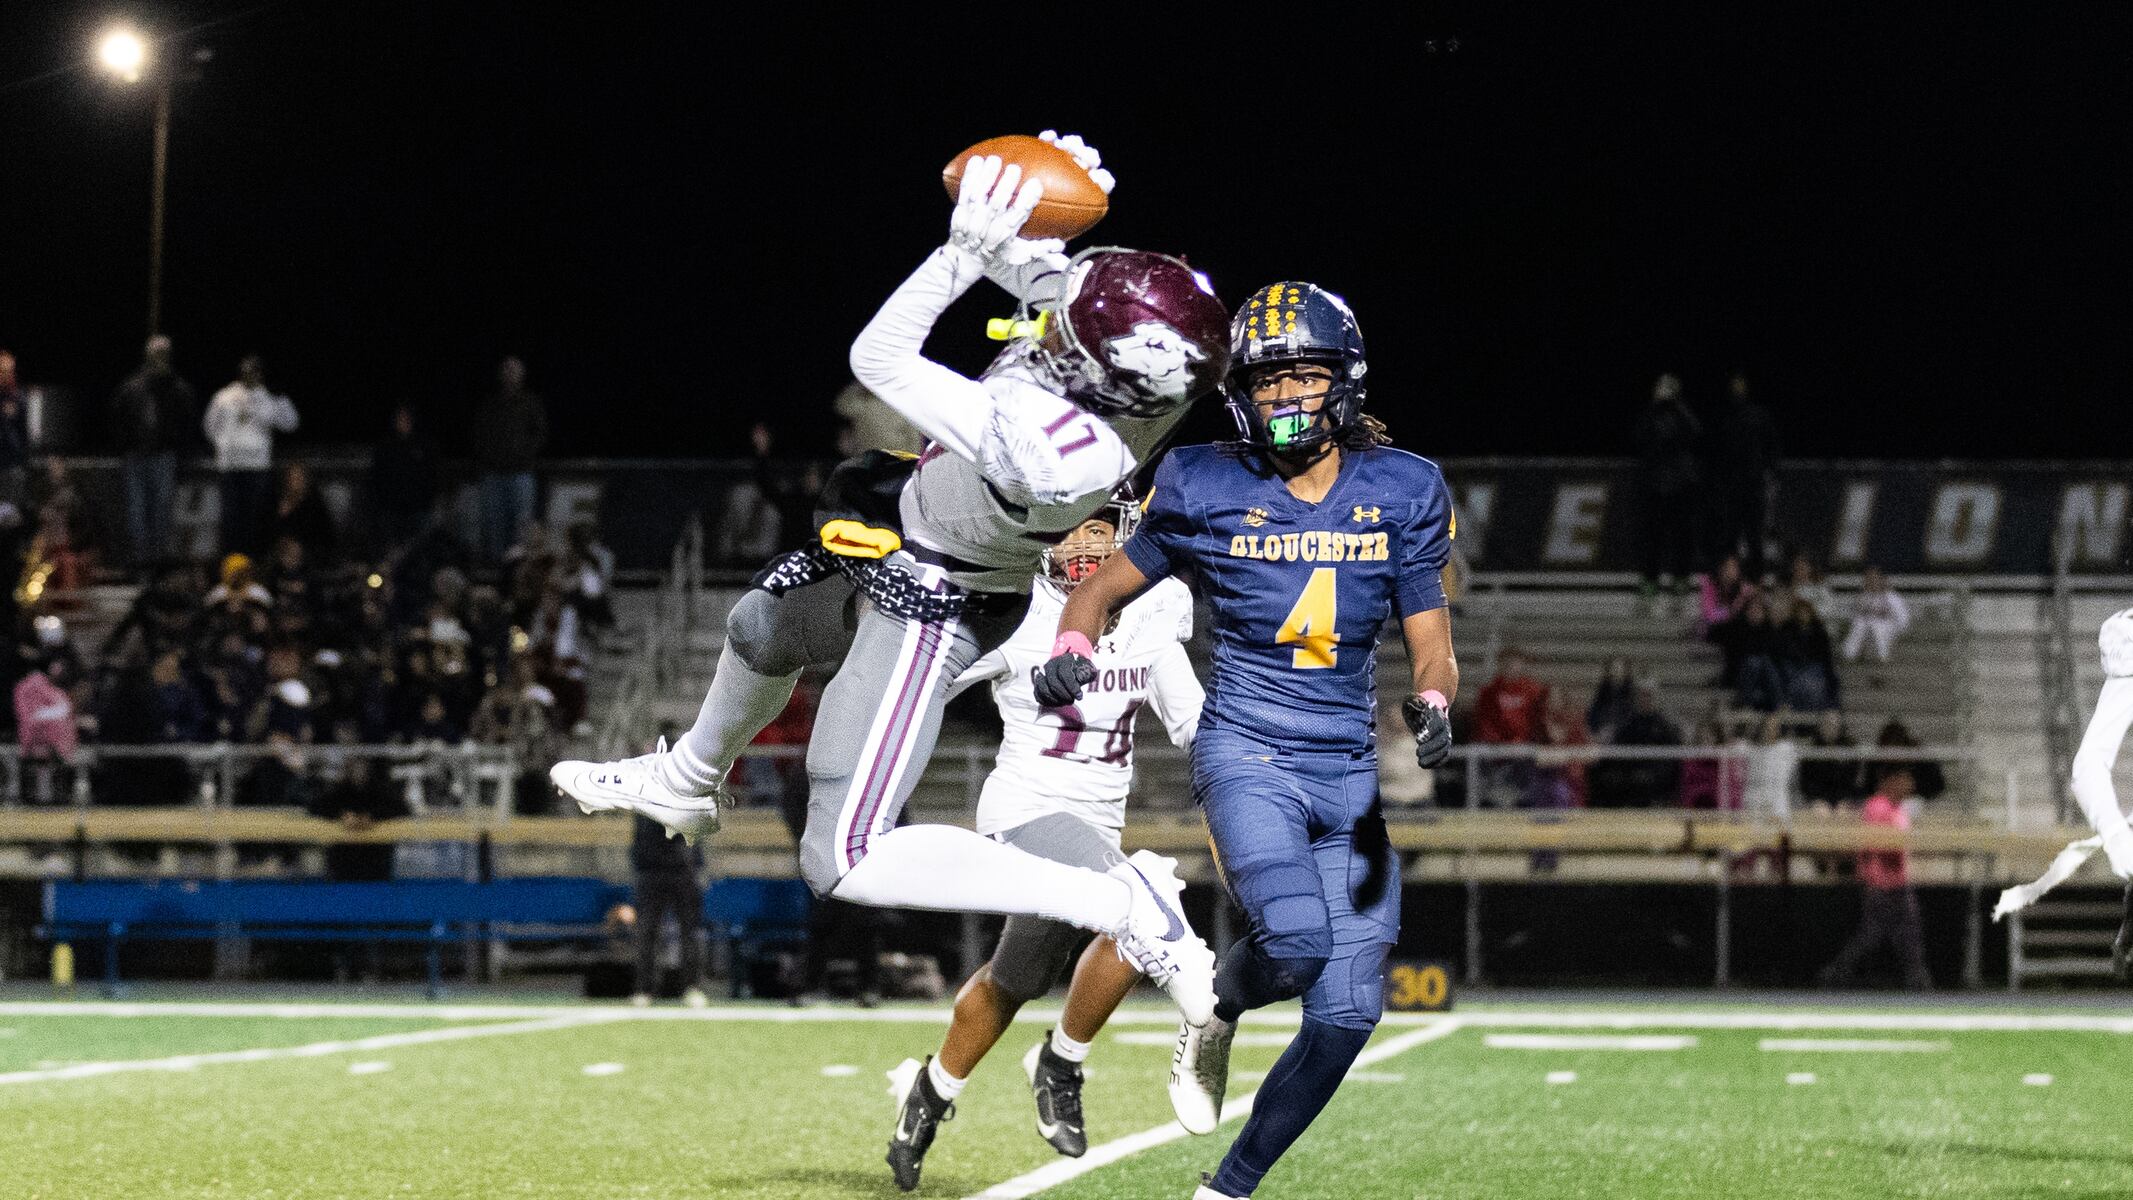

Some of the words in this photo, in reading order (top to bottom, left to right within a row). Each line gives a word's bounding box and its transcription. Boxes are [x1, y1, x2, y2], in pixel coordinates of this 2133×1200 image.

[1041, 406, 1099, 459] 17
[1229, 531, 1390, 562] GLOUCESTER
[1275, 567, 1341, 669] 4
[1391, 964, 1448, 1008] 30
[1169, 1022, 1190, 1087] ATTLE
